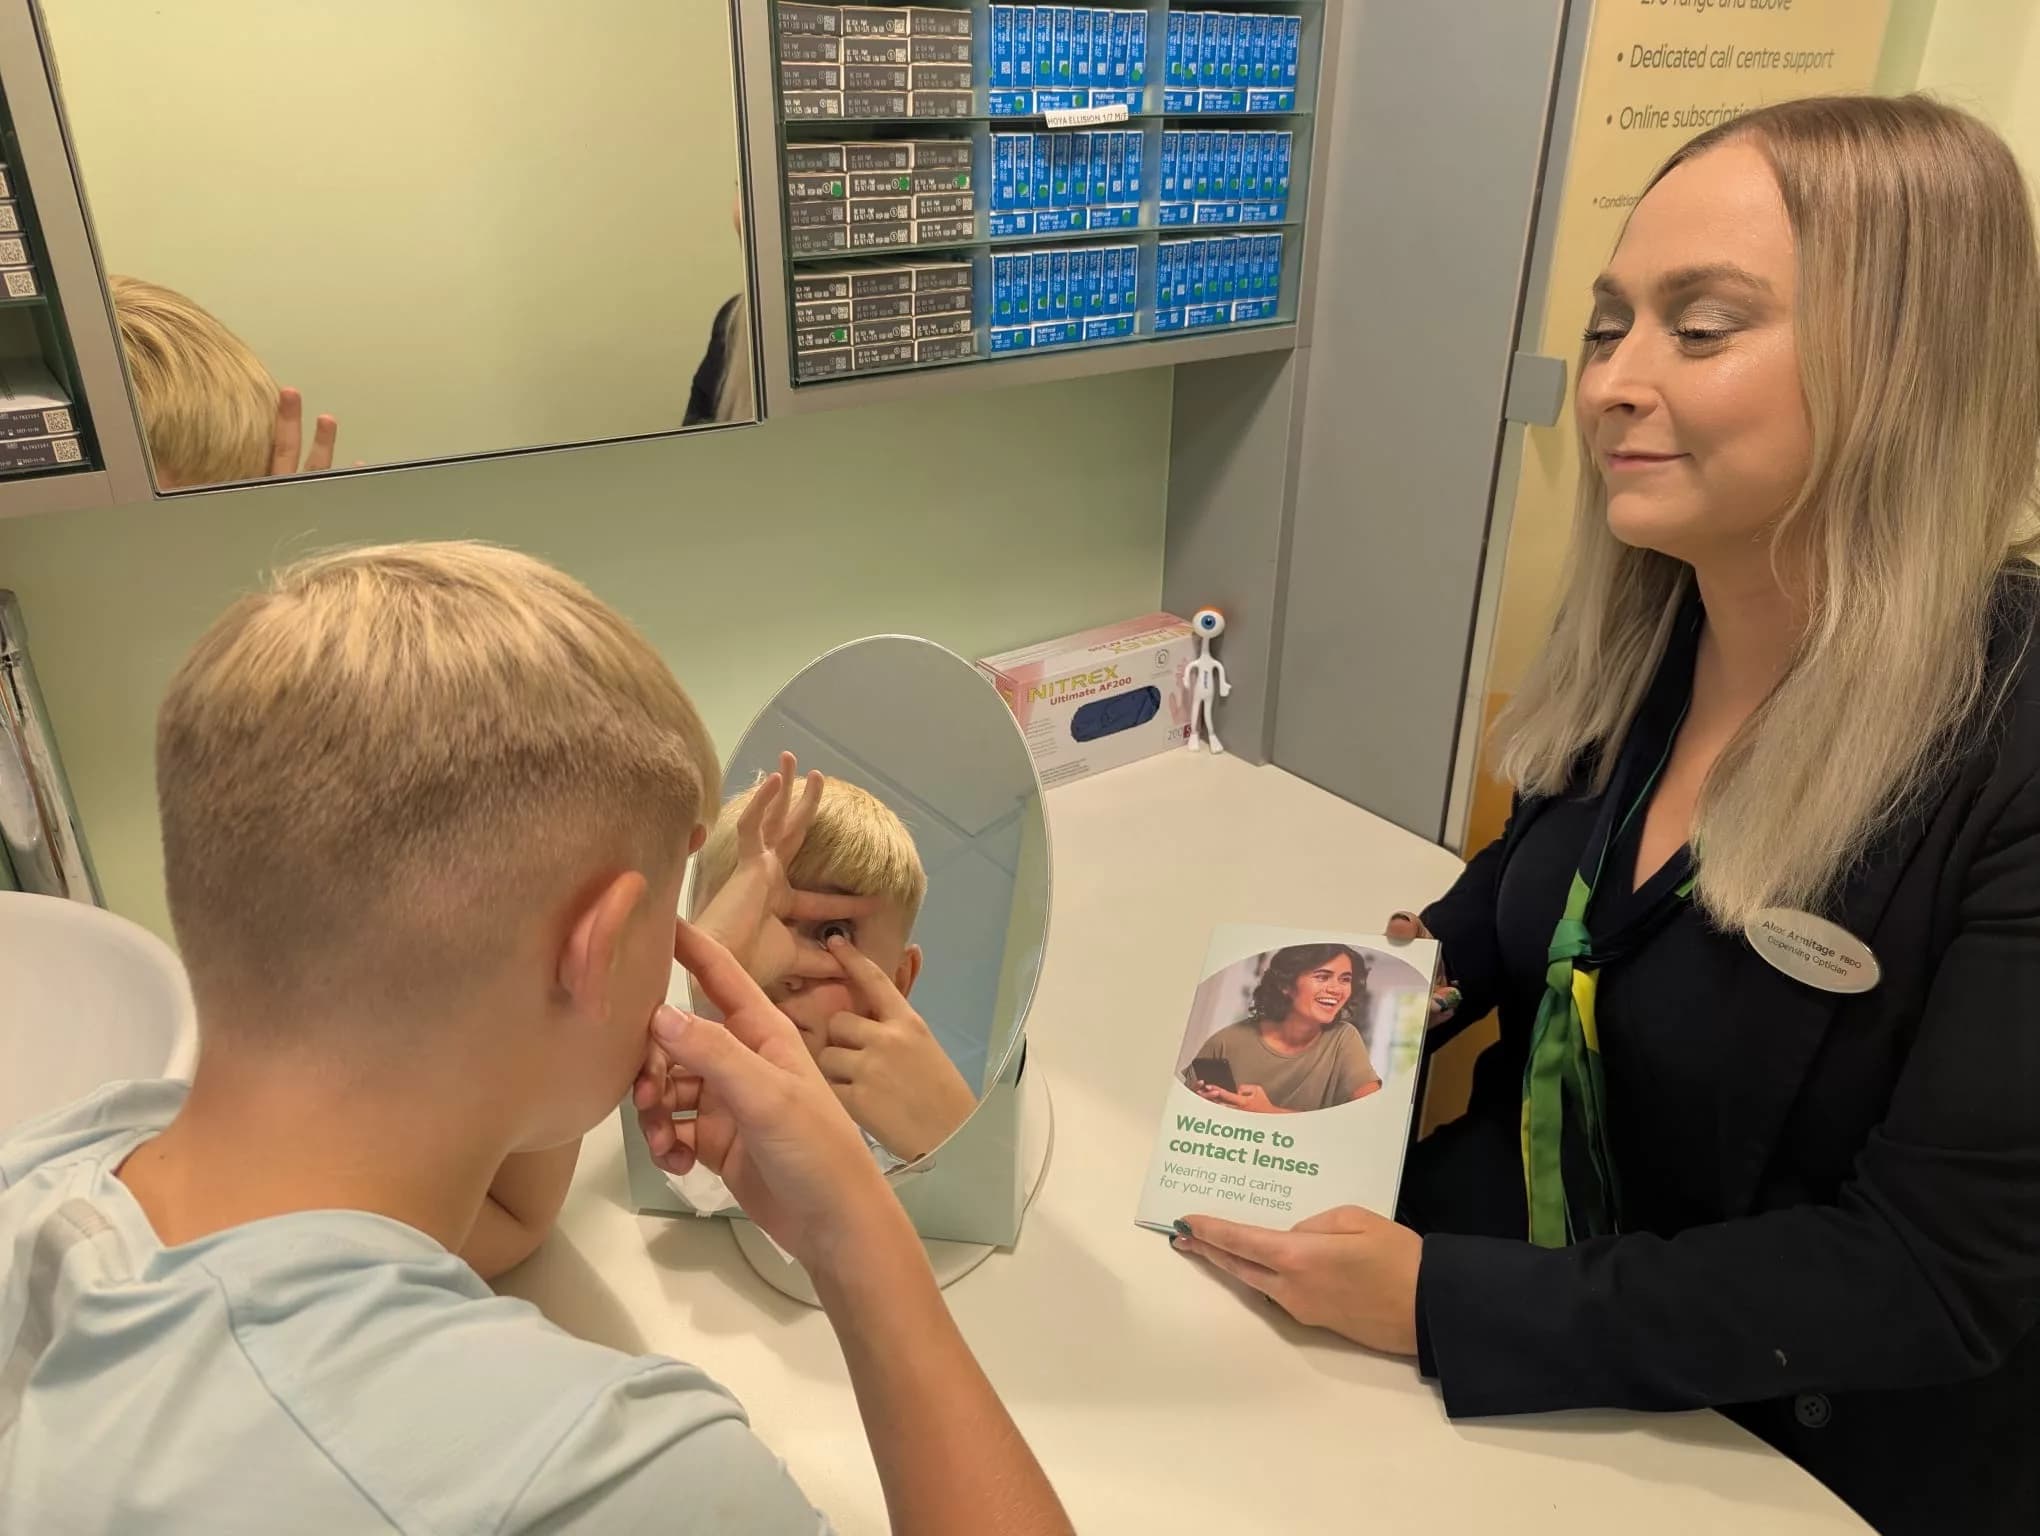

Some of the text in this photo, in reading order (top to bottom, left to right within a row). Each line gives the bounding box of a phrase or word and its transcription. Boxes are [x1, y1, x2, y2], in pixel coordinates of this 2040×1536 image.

[1630, 44, 1835, 75] Dedicated call centre support
[1047, 116, 1068, 126] HOYA
[1620, 103, 1753, 129] Online subscripti
[1027, 663, 1119, 704] NITREX
[1049, 676, 1132, 706] Ultimate AF200
[1787, 930, 1836, 957] Armitage
[1839, 955, 1862, 968] FBDO
[1812, 955, 1848, 976] Optician
[1176, 1114, 1294, 1149] Welcome to
[1169, 1139, 1320, 1176] contact lenses
[1159, 1175, 1293, 1211] for your new lenses
[1163, 1160, 1292, 1198] Wearing and caring
